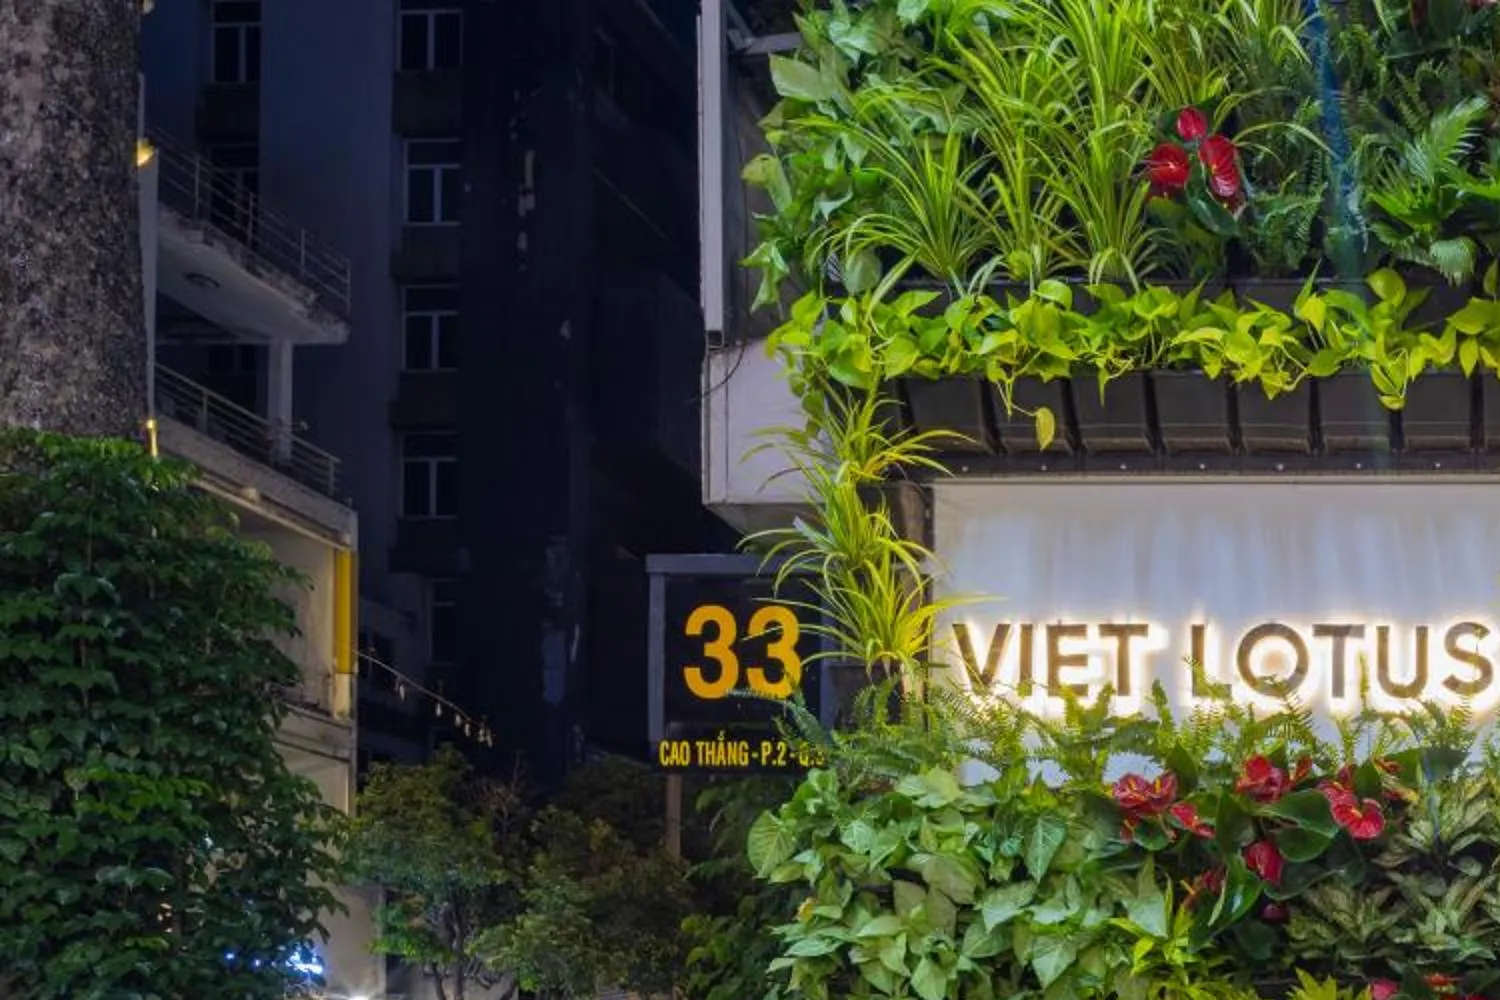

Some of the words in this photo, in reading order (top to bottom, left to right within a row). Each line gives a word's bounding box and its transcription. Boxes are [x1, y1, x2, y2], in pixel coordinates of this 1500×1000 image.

[684, 605, 802, 699] 33
[952, 623, 1150, 697] VIET
[1191, 621, 1493, 698] LOTUS
[659, 740, 691, 767] CAO
